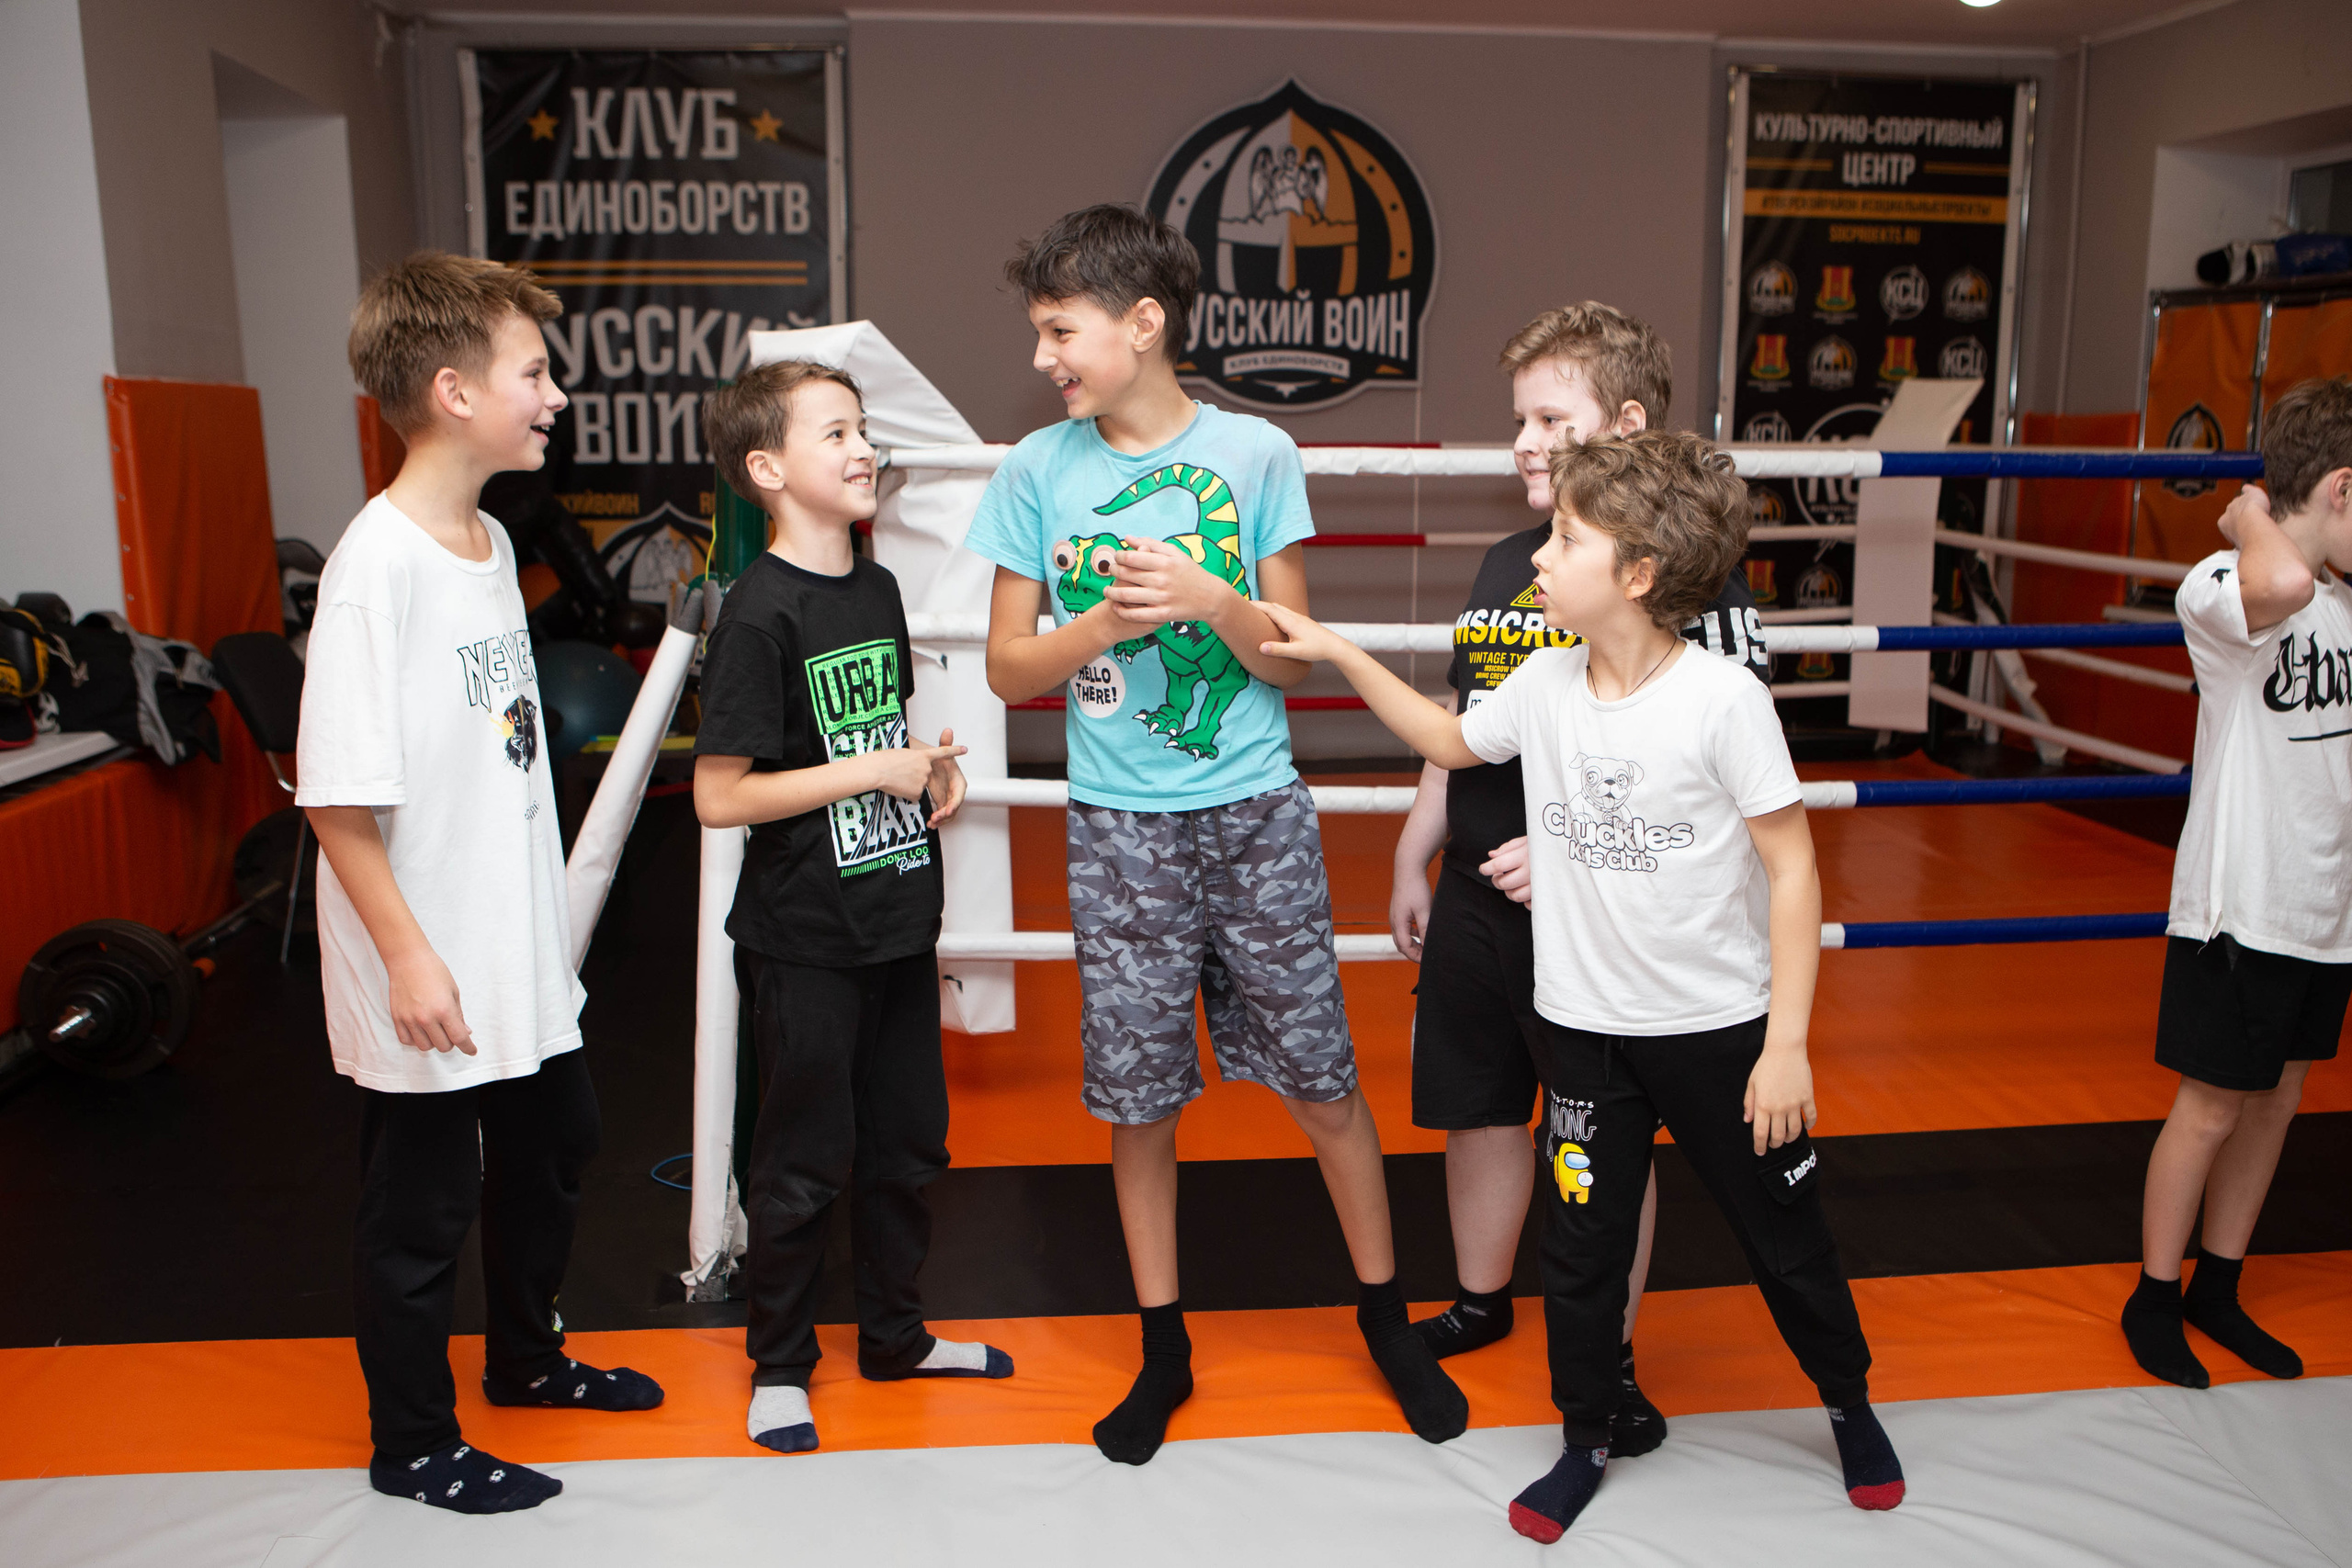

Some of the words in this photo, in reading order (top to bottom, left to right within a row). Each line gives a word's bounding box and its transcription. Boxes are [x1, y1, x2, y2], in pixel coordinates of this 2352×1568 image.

[570, 86, 739, 160] КЛУБ
[1754, 111, 2004, 149] КУЛЬТУРНО-СПОРТИВНЫЙ
[1842, 151, 1917, 186] ЦЕНТР
[503, 179, 811, 242] ЕДИНОБОРСТВ
[1184, 288, 1314, 353] УССКИЙ
[1324, 288, 1411, 362] ВОИН
[571, 391, 716, 465] ВОИ
[1078, 665, 1112, 684] HELLO
[1469, 651, 1508, 665] VINTAGE
[1075, 682, 1117, 705] THERE!
[1606, 850, 1658, 874] Club
